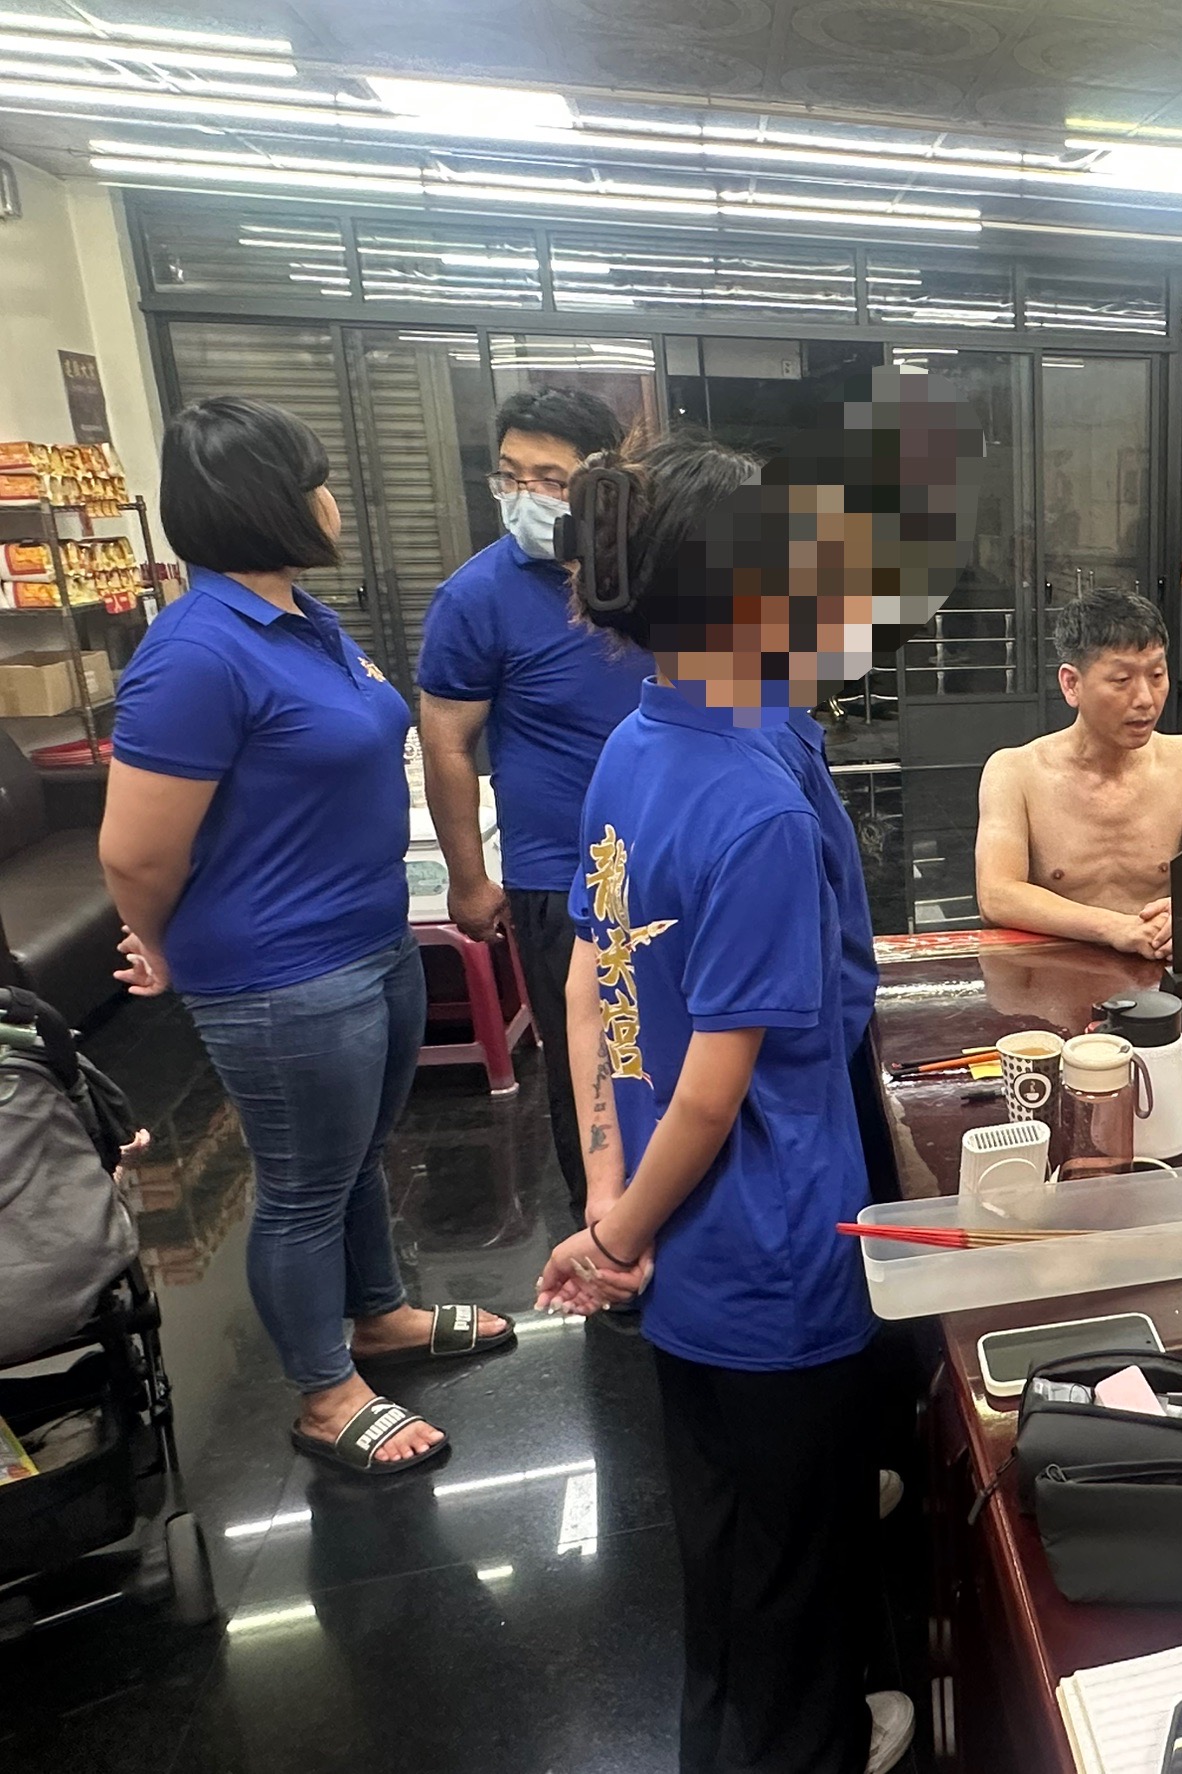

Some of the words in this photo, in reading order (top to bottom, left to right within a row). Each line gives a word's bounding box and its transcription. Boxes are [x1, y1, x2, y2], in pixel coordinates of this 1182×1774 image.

[586, 823, 664, 1080] 龍天宮
[356, 1408, 406, 1451] PUMA
